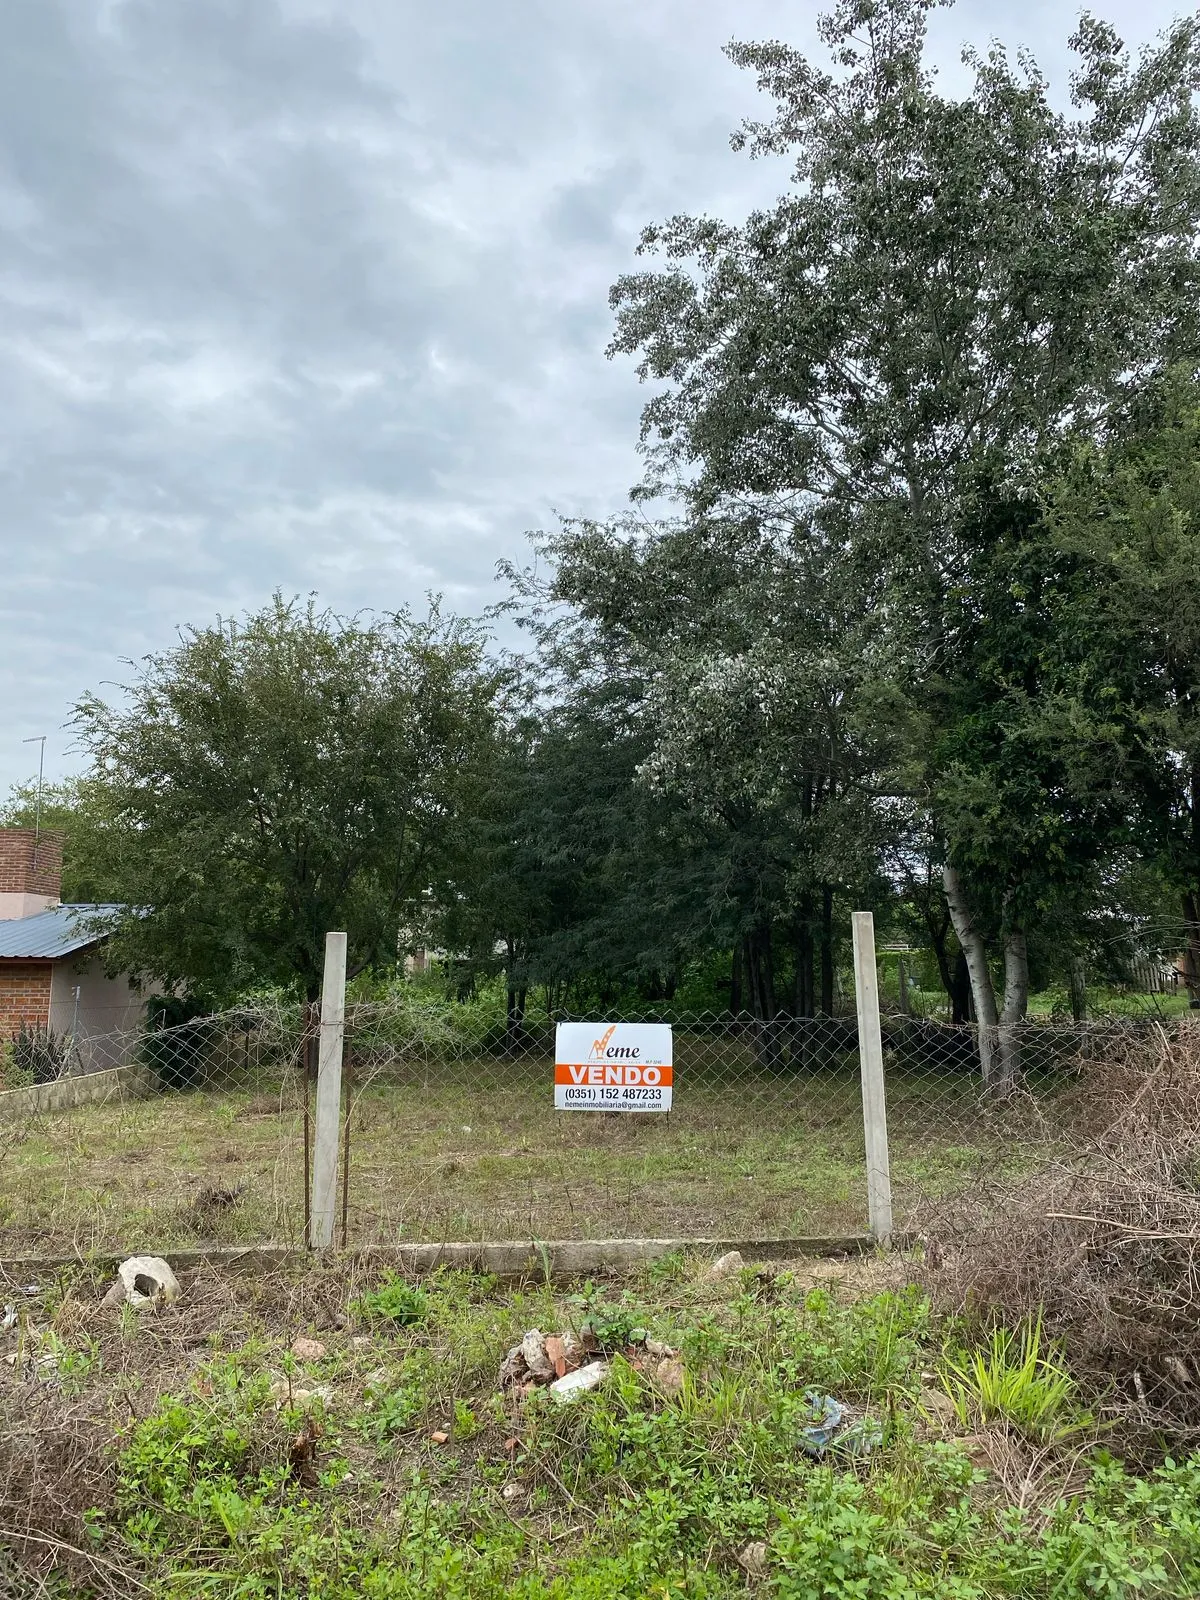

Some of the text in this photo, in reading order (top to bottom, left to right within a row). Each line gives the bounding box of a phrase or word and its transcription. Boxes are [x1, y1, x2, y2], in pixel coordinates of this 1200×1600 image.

[588, 1025, 640, 1059] Neme
[568, 1066, 661, 1085] VENDO
[565, 1089, 662, 1100] (0351) 152 487233
[564, 1101, 662, 1109] nemeinmobiliaria@gmail.com
